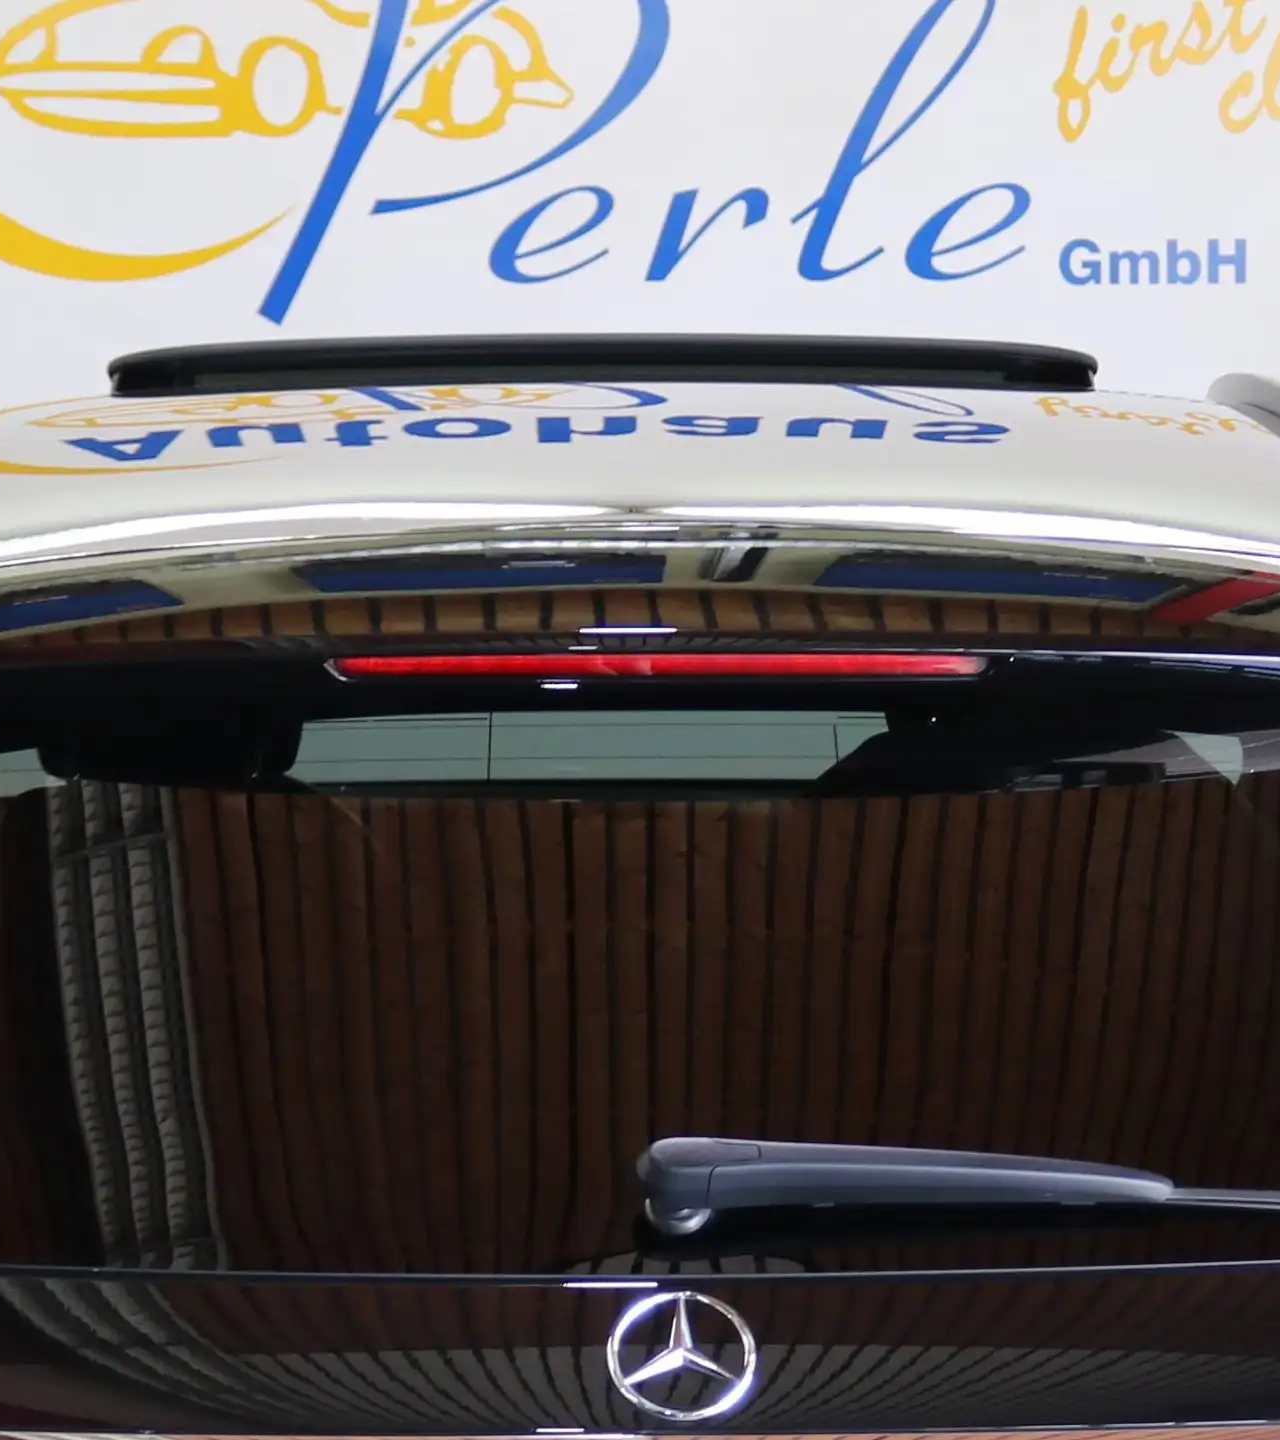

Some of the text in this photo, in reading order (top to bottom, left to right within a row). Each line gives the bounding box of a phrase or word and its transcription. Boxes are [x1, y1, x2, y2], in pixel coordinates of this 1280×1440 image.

[1052, 0, 1267, 143] first
[258, 0, 1032, 325] Perle
[1059, 238, 1247, 285] GmbH
